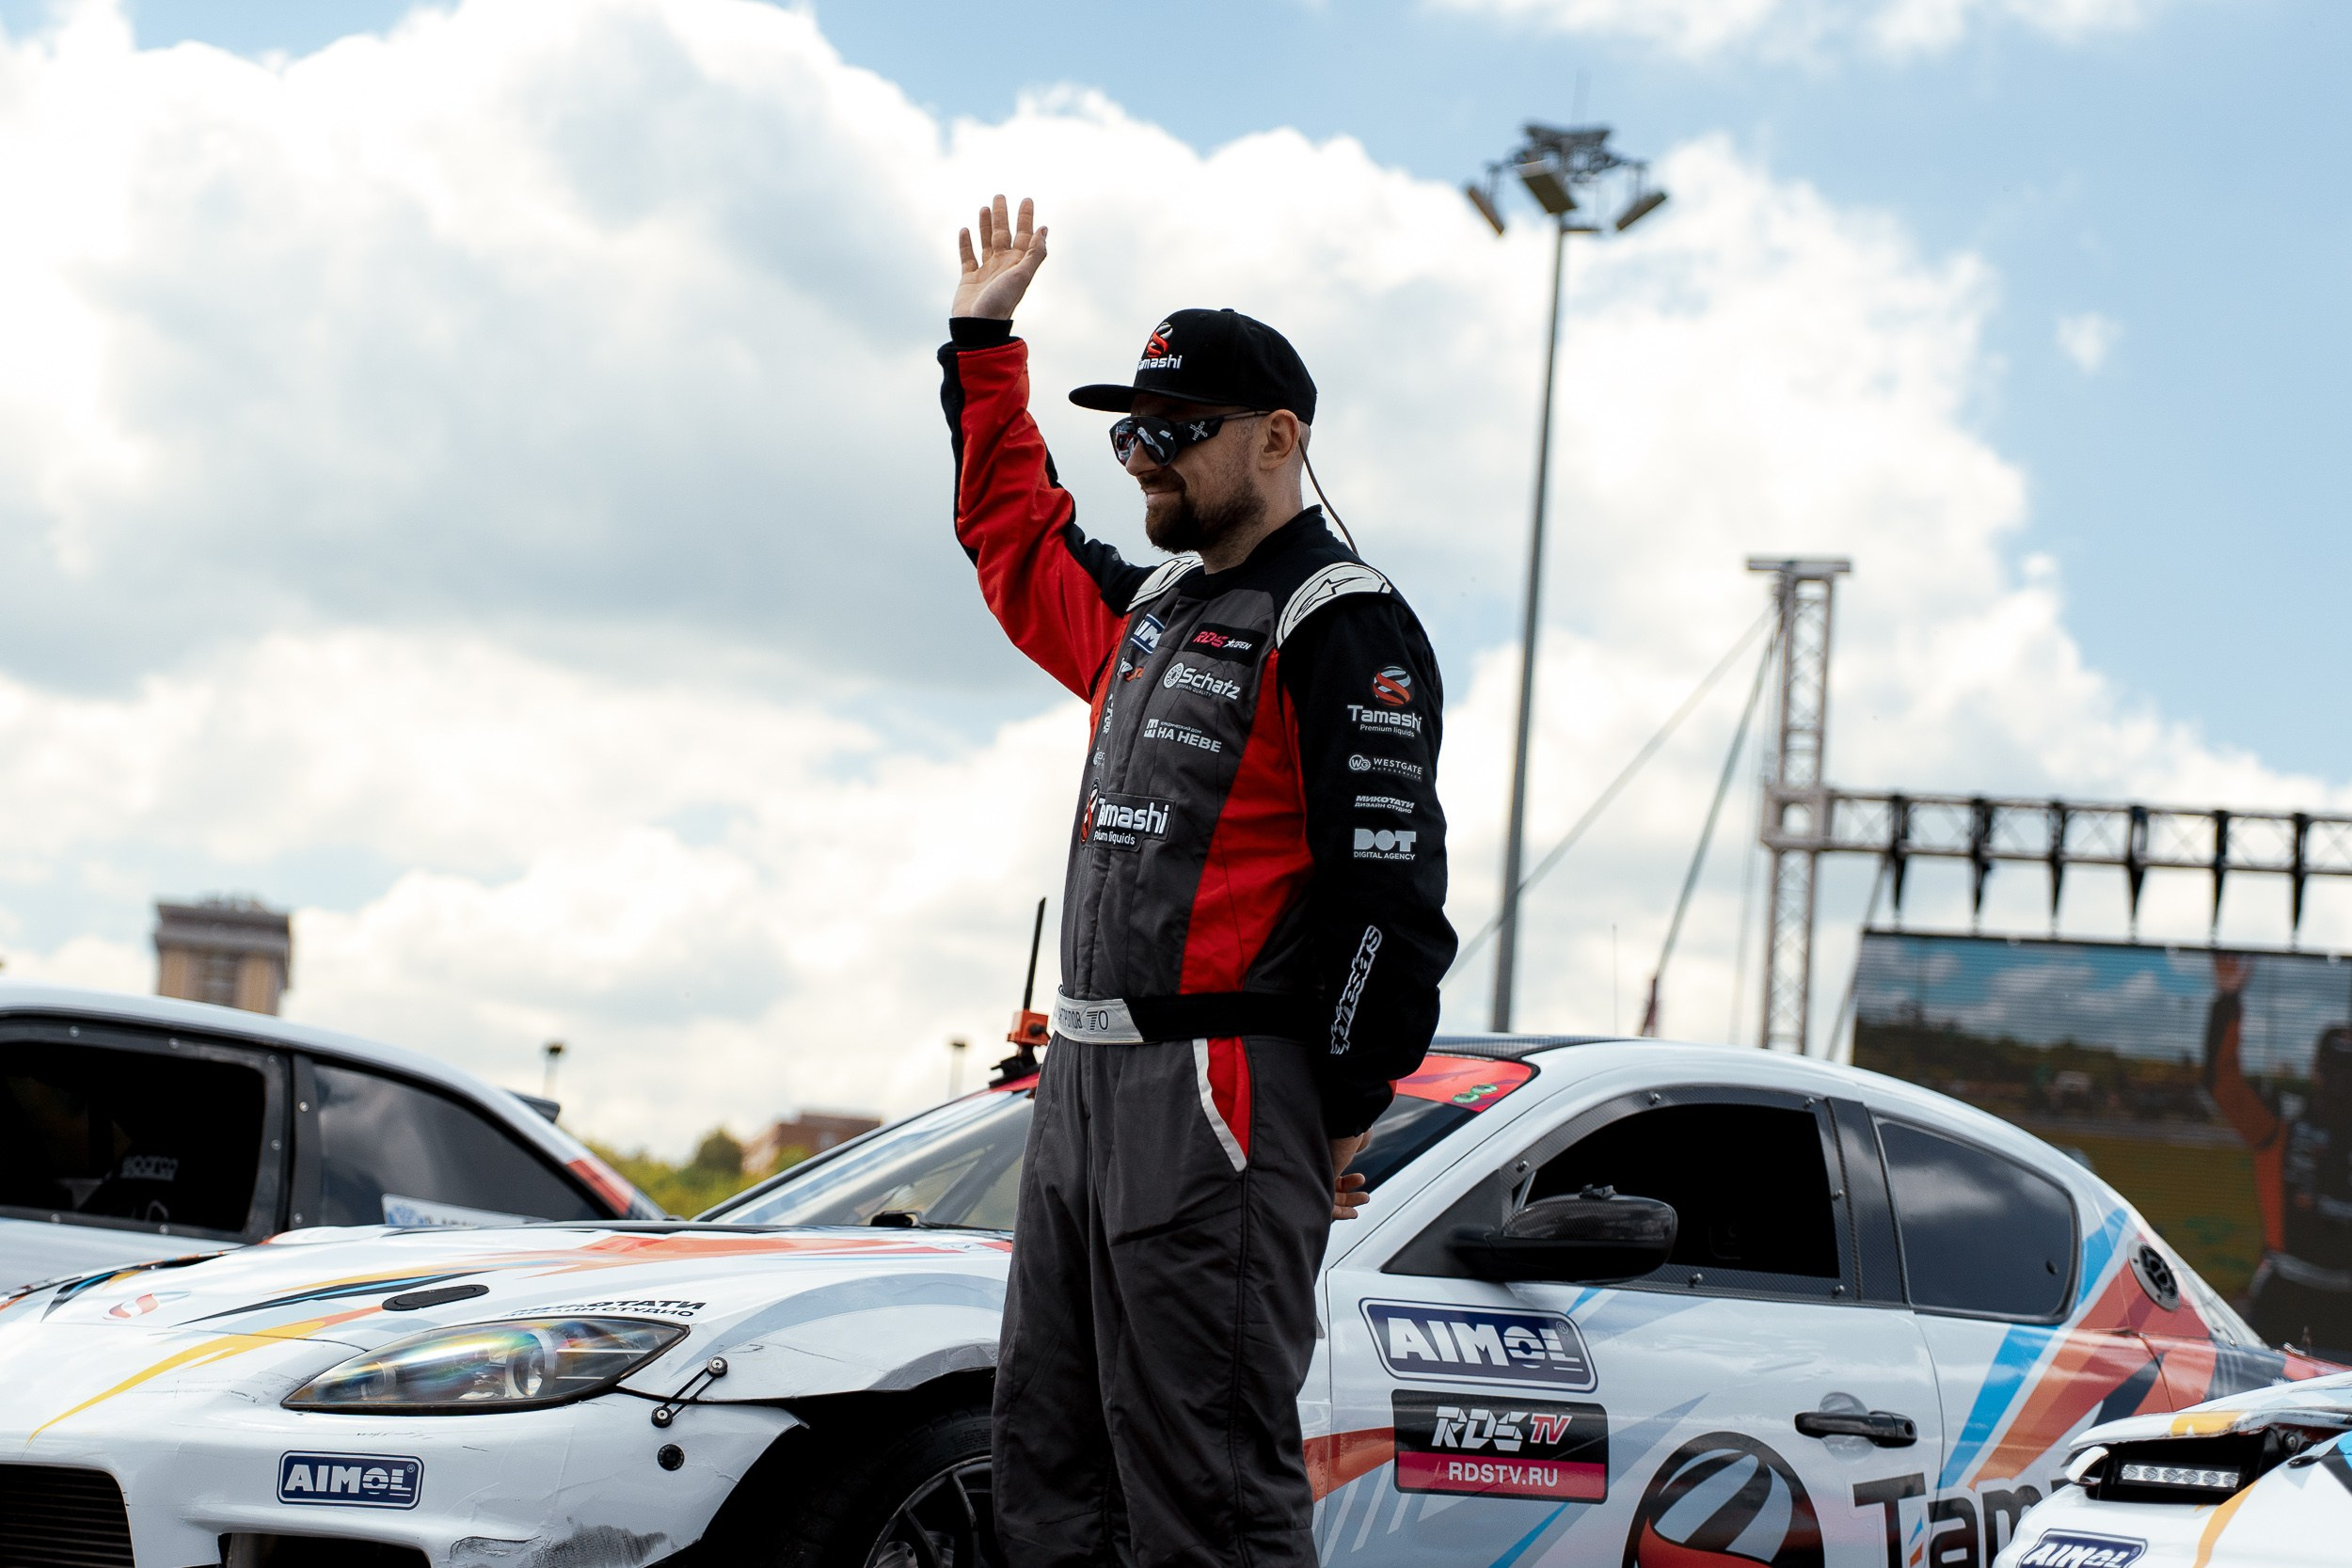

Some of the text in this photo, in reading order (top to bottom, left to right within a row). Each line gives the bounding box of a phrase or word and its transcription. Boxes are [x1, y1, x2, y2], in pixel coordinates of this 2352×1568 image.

[1138, 354, 1183, 371] amashi
[1193, 631, 1229, 647] RDS
[1179, 667, 1241, 700] Schatz
[1347, 705, 1422, 733] Tamashi
[1156, 727, 1222, 752] НА НЕВЕ
[1393, 727, 1414, 736] liquids
[1374, 758, 1422, 775] WESTGATE
[1356, 795, 1415, 809] МИКОТАТИ
[1386, 803, 1412, 814] СТУДИО
[1354, 829, 1417, 852] DOT
[1384, 852, 1415, 861] AGENCY
[1086, 1009, 1109, 1031] 70
[1386, 1317, 1584, 1372] AIMOL
[1431, 1405, 1573, 1451] RDS TV
[283, 1464, 412, 1497] AIMOL
[1448, 1461, 1559, 1487] RDSTV.RU
